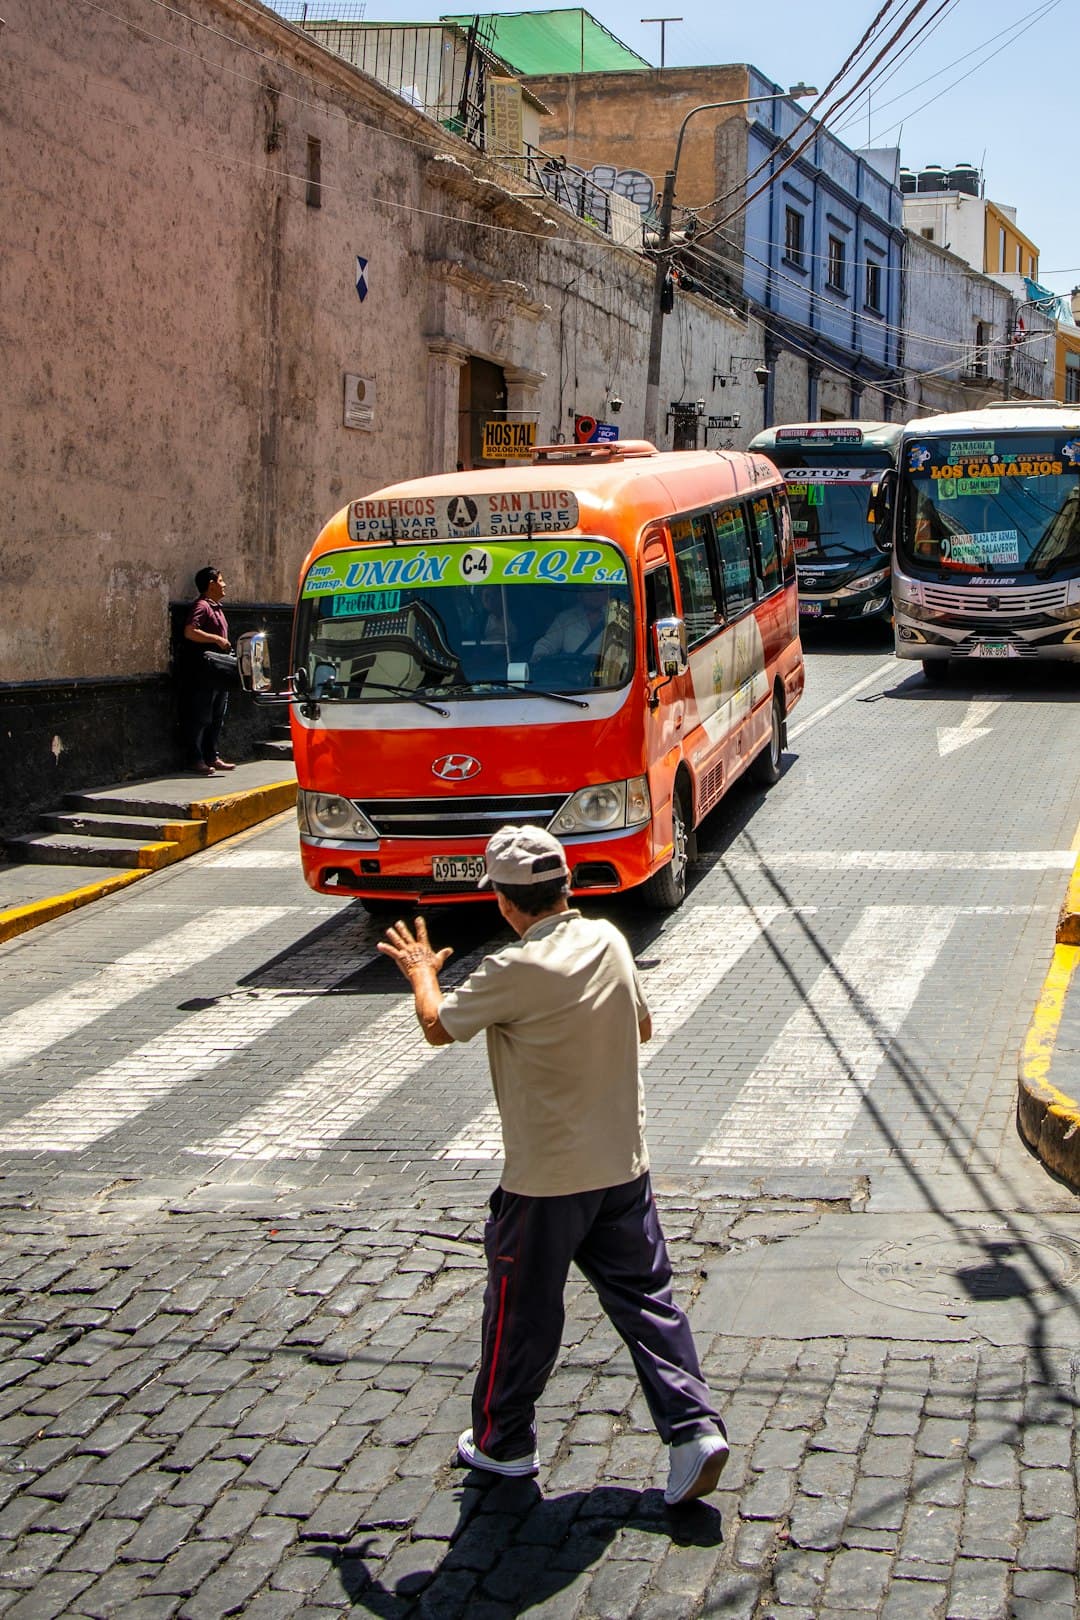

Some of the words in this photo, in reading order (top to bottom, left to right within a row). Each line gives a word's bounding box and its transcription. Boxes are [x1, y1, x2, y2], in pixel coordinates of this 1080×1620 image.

[486, 424, 533, 446] HOSTAL
[783, 469, 850, 479] COTUM
[931, 466, 963, 479] LOS
[968, 462, 1062, 477] CANARIOS
[354, 499, 436, 519] GRAFICOS
[452, 496, 473, 524] A
[489, 494, 521, 512] SAN
[529, 492, 569, 511] LUIS
[356, 517, 436, 530] BOLIVAR
[490, 510, 570, 524] SUCRE
[356, 531, 376, 542] LA
[379, 528, 438, 541] MERCED
[490, 521, 570, 535] SALAVERRY
[974, 533, 989, 544] PLAZA
[991, 532, 998, 542] DE
[999, 530, 1017, 541] ARMAS
[982, 542, 1017, 554] SALAVERRY
[992, 553, 1018, 563] AVELINO
[309, 566, 334, 577] Emp.
[344, 550, 451, 588] UNIÓN
[462, 552, 487, 576] C-4
[504, 550, 602, 582] AQP
[306, 578, 343, 592] Transp.
[435, 863, 483, 879] A9D-959
